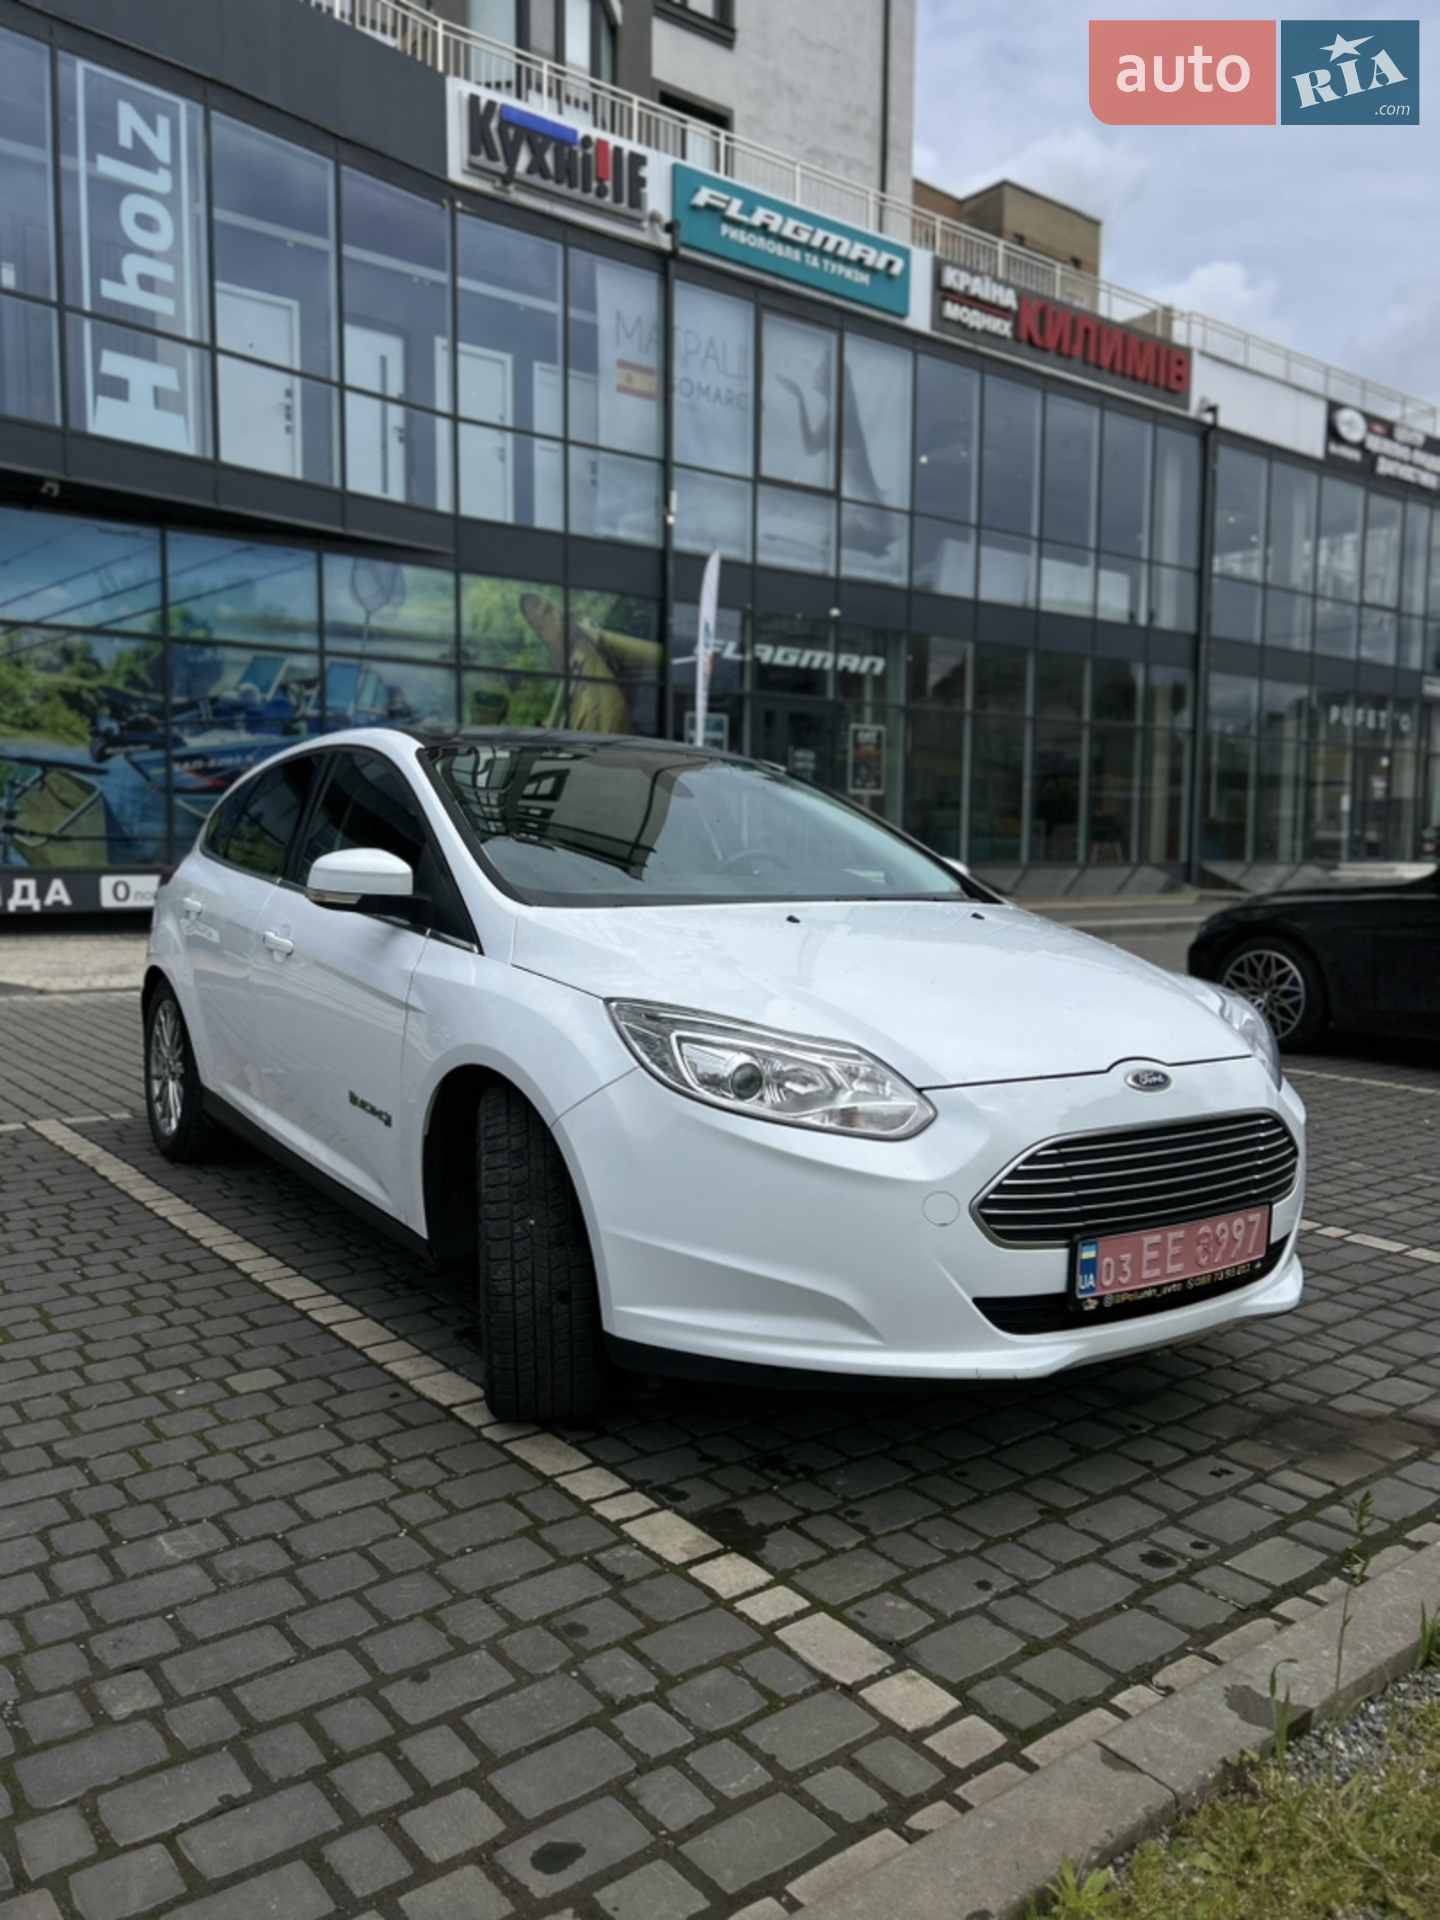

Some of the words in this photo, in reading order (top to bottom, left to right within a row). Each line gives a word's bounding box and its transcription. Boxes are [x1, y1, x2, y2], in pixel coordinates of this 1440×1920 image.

[96, 99, 175, 317] holz
[690, 186, 905, 277] FLAGMAN
[720, 223, 800, 262] РИБОЛОВЛЯ
[804, 252, 820, 270] ТА
[822, 258, 871, 287] ТУРИЗМ
[941, 264, 1018, 311] КРАЇНА
[942, 299, 1013, 339] МОДНИХ
[1019, 293, 1190, 393] КИЛИМІВ
[1329, 704, 1412, 733] PUFETO
[0, 878, 73, 912] ДА
[1079, 1272, 1096, 1290] UA
[1101, 1253, 1132, 1288] 03
[1141, 1230, 1186, 1279] EE
